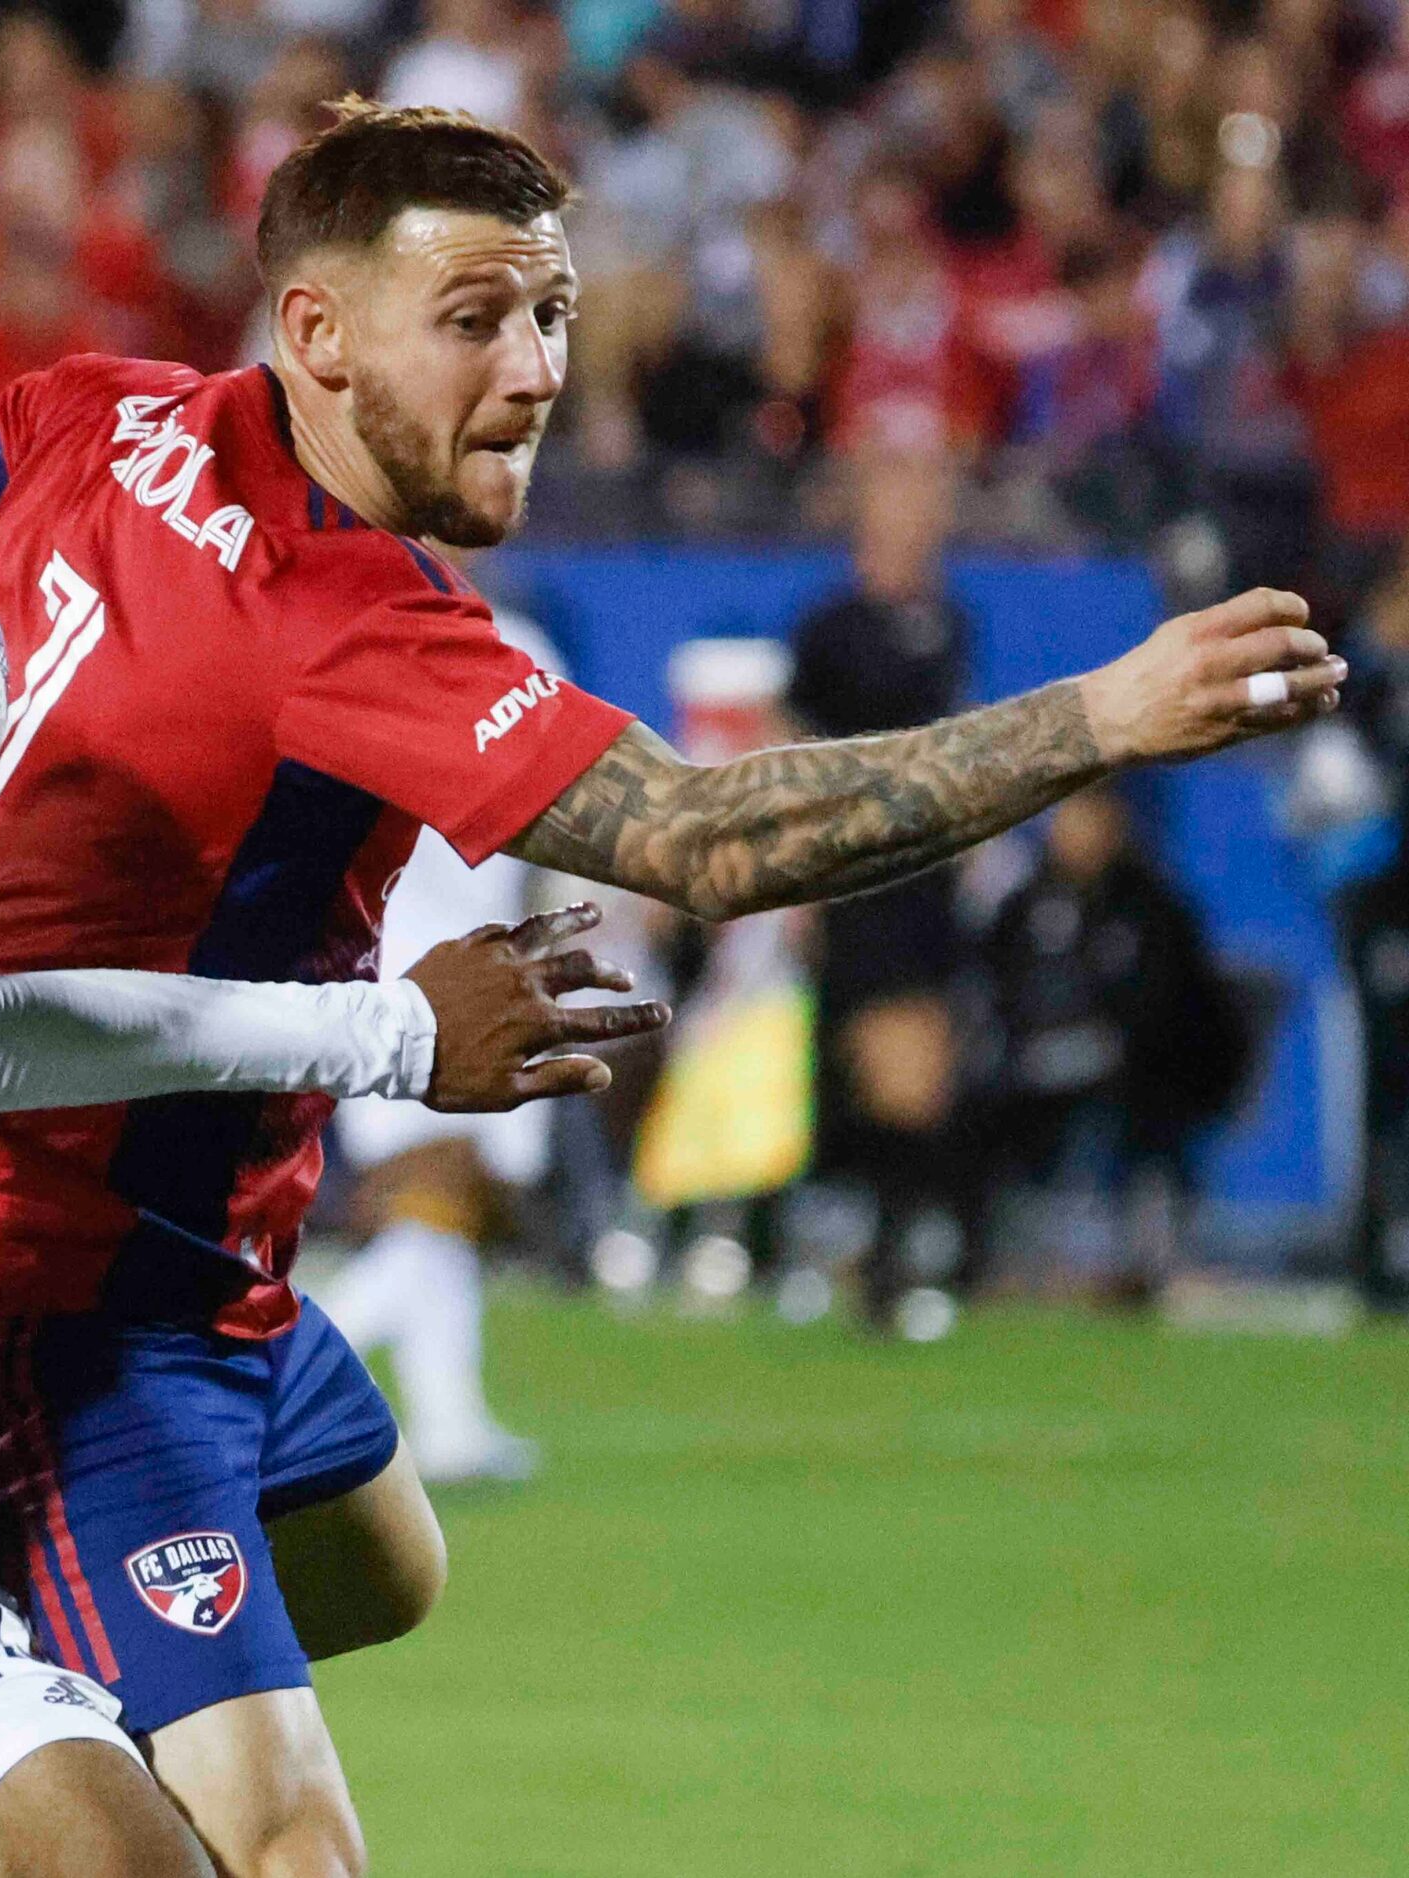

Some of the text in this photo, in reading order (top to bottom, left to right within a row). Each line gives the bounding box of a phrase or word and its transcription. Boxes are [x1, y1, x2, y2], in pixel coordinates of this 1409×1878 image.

[474, 672, 561, 753] ADVO
[138, 1538, 232, 1583] FC DALLAS
